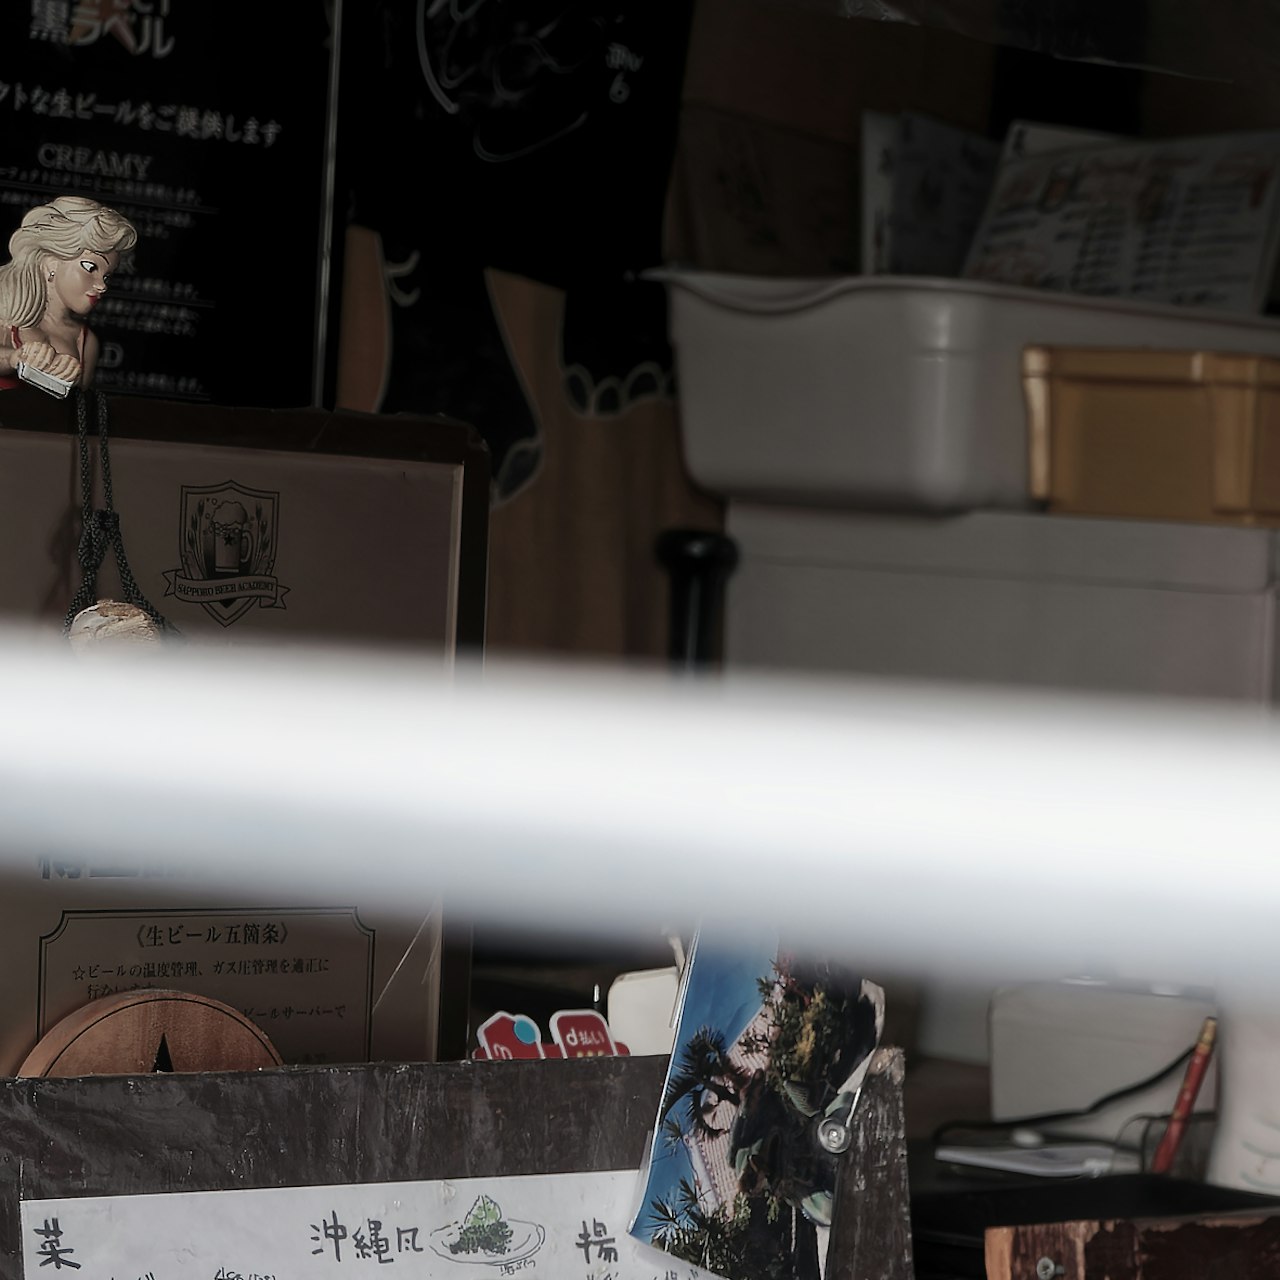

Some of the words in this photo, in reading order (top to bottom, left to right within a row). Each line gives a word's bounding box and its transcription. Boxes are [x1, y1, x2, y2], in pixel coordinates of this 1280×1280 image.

[37, 142, 152, 180] CREAMY
[178, 583, 214, 596] SAPPORO
[215, 583, 236, 595] BEER
[238, 581, 274, 592] ACADEMY
[33, 1217, 82, 1270] 菜
